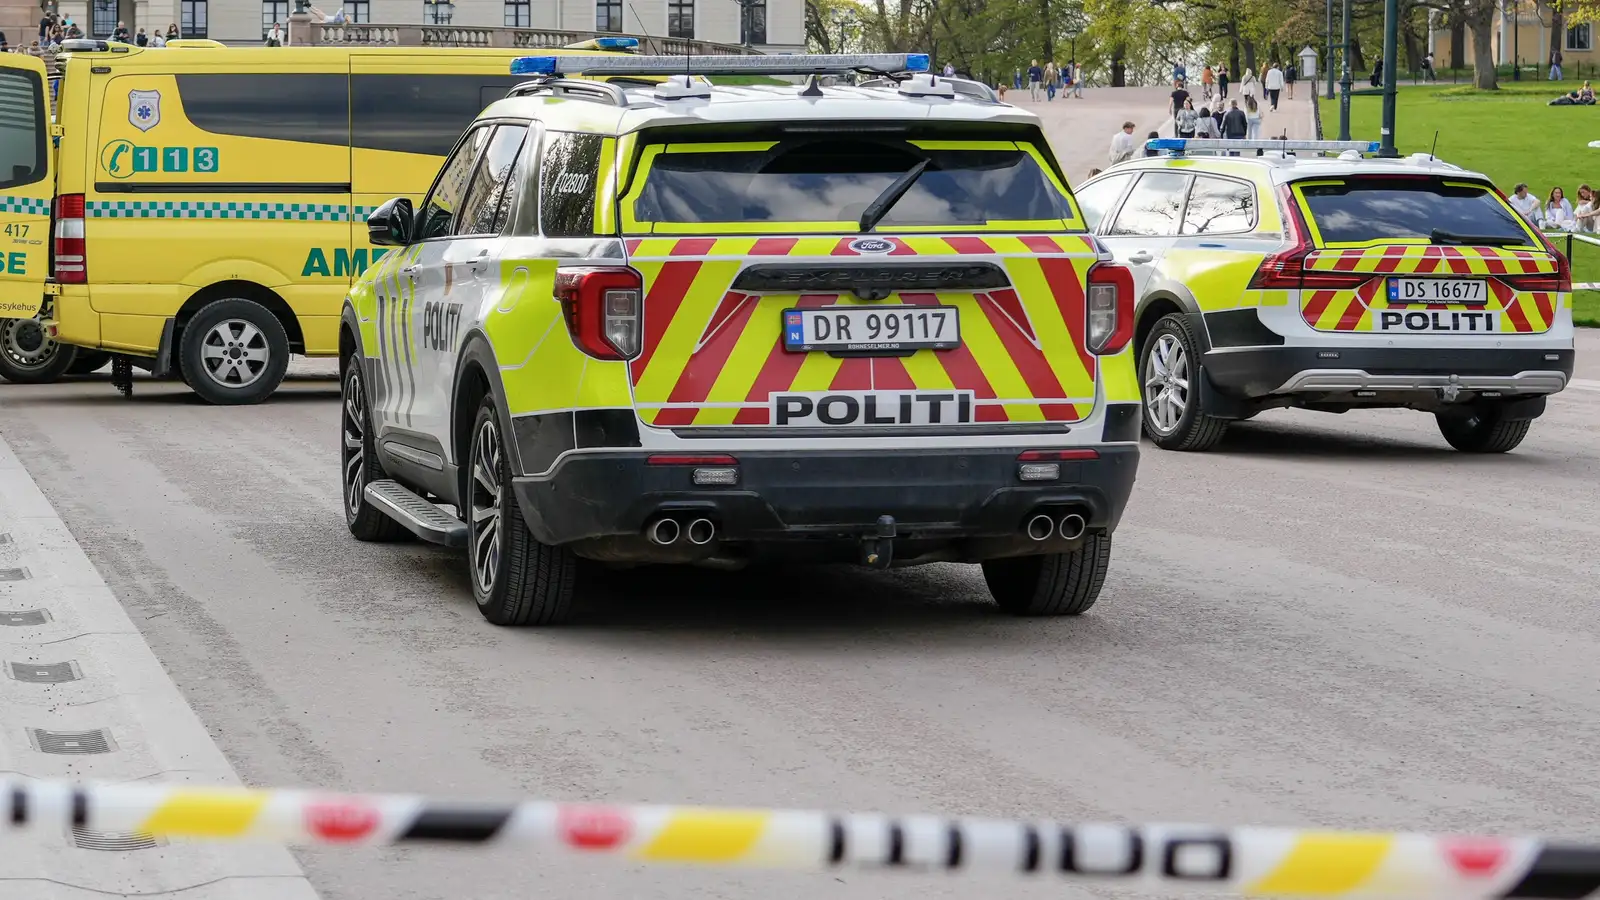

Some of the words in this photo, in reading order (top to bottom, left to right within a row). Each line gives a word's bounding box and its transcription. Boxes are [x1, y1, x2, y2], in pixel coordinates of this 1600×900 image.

[138, 148, 214, 170] 113
[558, 172, 589, 194] 02800
[4, 223, 30, 238] 417
[0, 251, 27, 275] E
[780, 270, 966, 284] EXPLORER
[1404, 281, 1426, 298] DS
[1432, 282, 1481, 299] 16677
[423, 301, 464, 354] POLITI
[813, 314, 852, 341] DR
[865, 312, 947, 341] 99117
[1380, 311, 1493, 332] POLITI
[791, 332, 800, 341] N
[775, 393, 971, 426] POLITI
